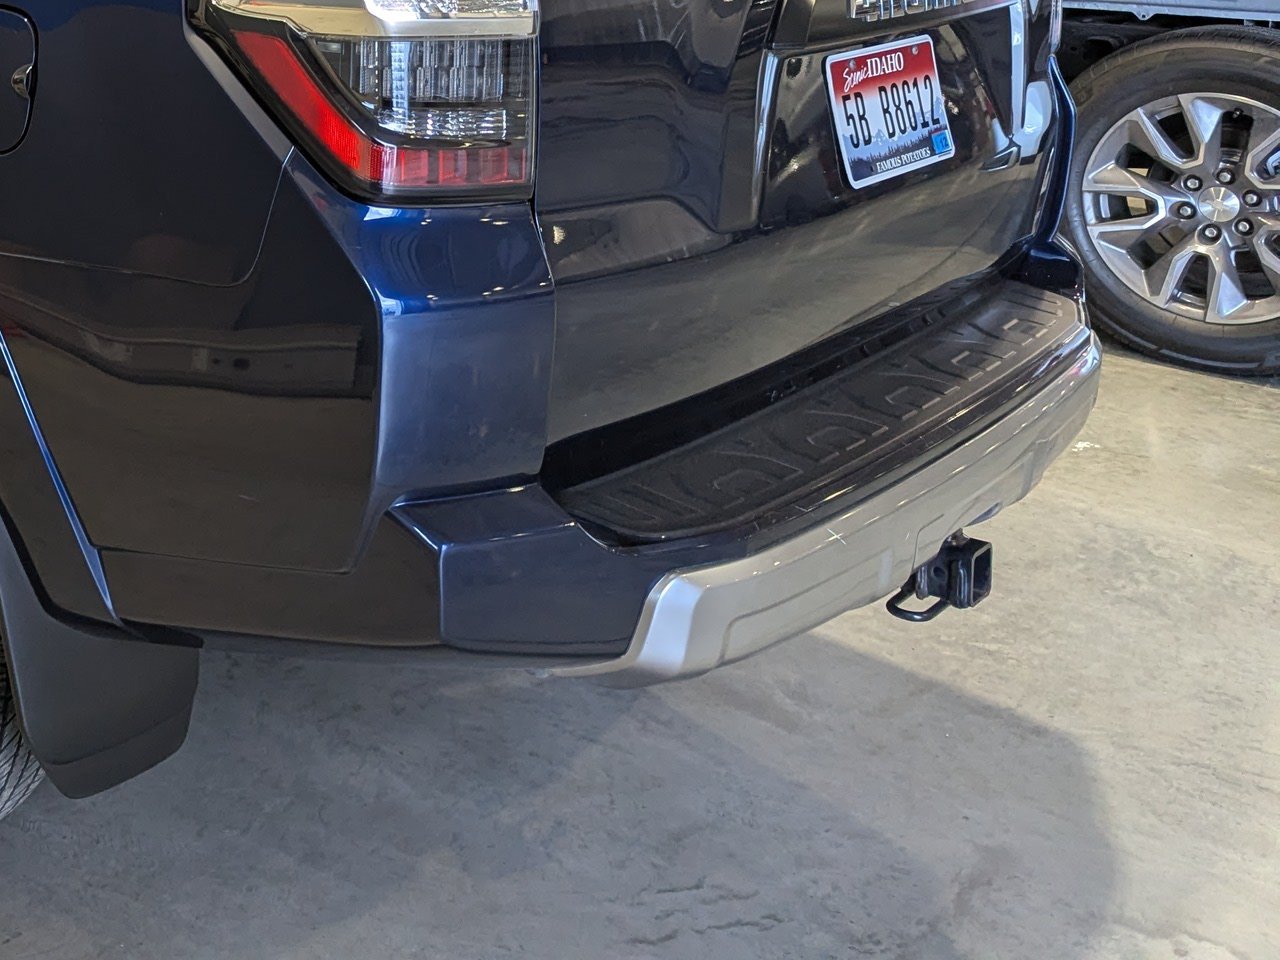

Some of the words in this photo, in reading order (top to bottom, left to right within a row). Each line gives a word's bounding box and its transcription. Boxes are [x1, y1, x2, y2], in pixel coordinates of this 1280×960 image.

[866, 51, 904, 78] IDAHO
[841, 91, 873, 149] 5B
[878, 74, 941, 139] B8612
[876, 156, 903, 173] FAMOUS
[901, 146, 932, 165] POTATOES
